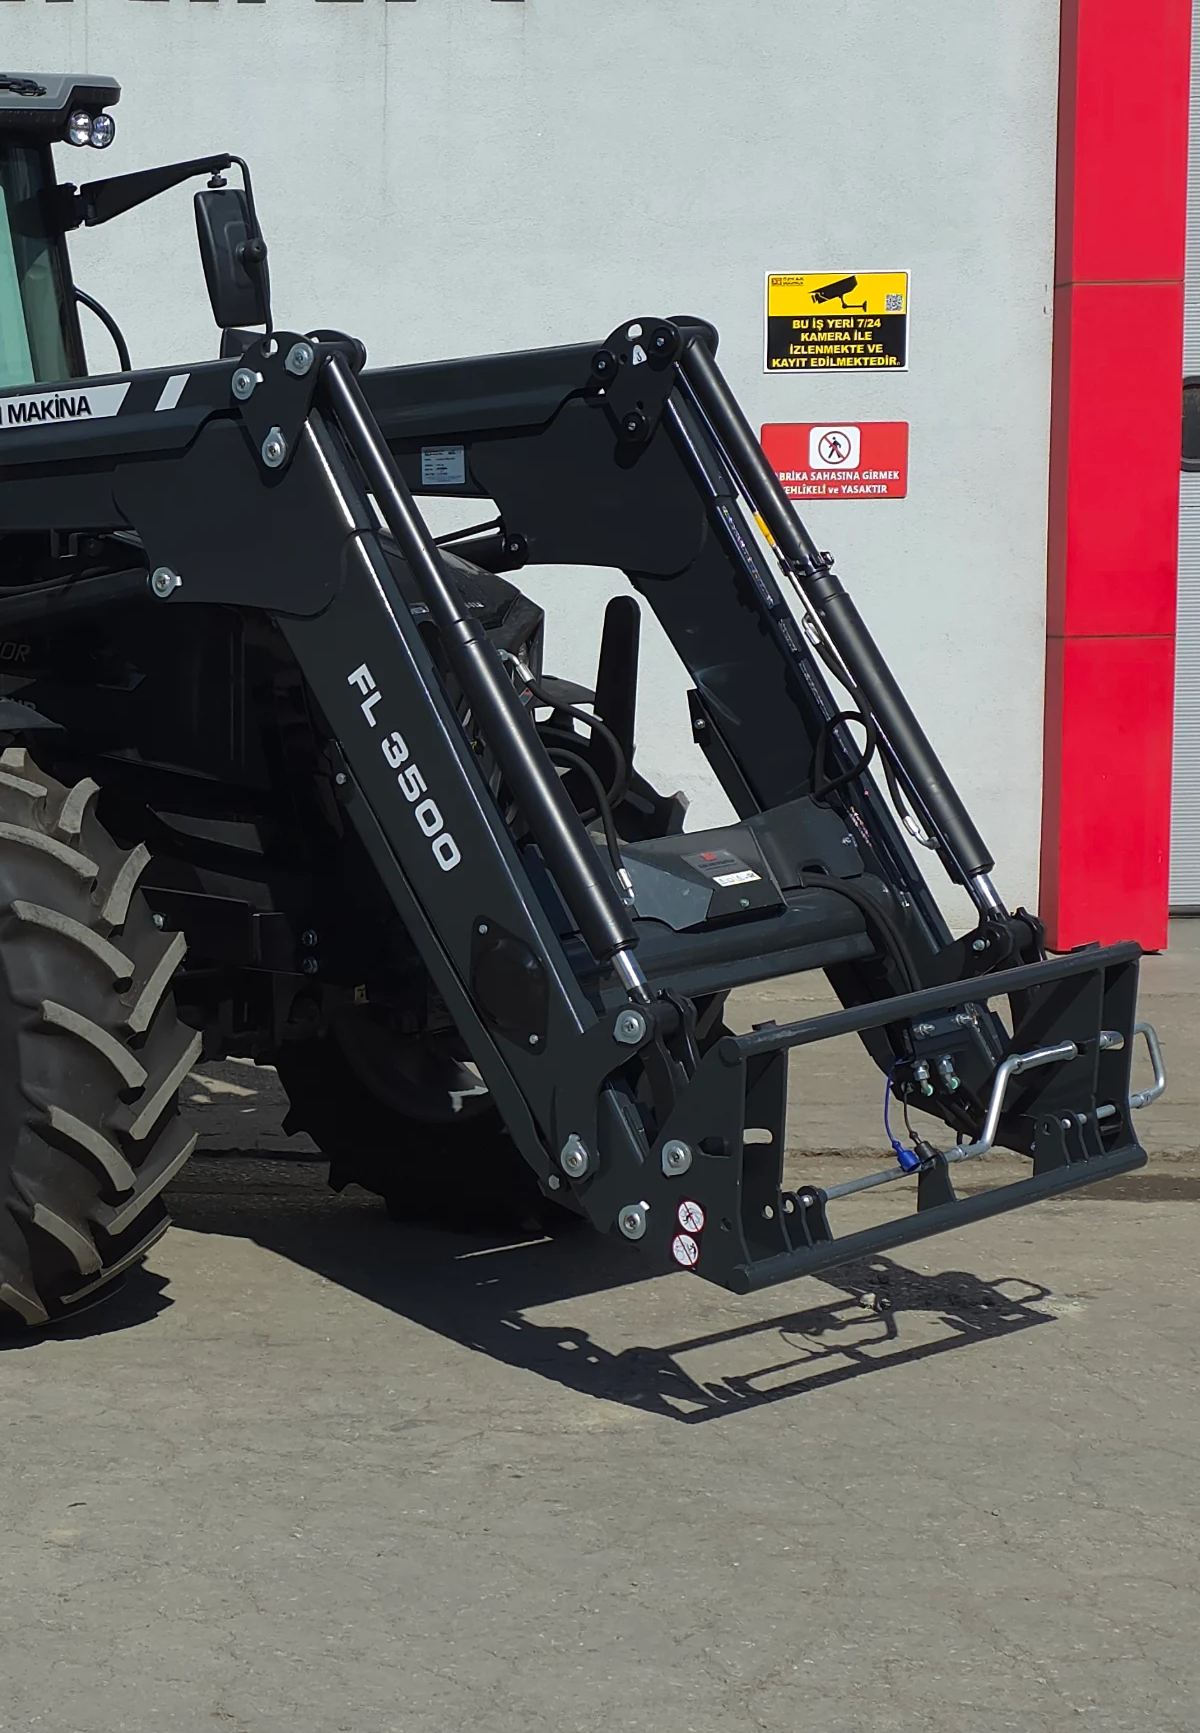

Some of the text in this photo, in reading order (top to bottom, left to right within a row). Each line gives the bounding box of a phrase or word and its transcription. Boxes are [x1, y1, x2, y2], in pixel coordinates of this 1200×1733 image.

[792, 317, 881, 331] BU İŞ YERİ 7/24
[801, 330, 873, 342] KAMERA İLE
[789, 343, 883, 354] İZLENMEKTE VE
[772, 357, 809, 368] KAYIT
[8, 394, 92, 423] MAKİNA
[777, 470, 900, 481] BRİKA SAHASINA GİRMEK
[828, 486, 839, 494] ve
[841, 484, 888, 494] YASAKTIR
[347, 663, 461, 872] FL 3500
